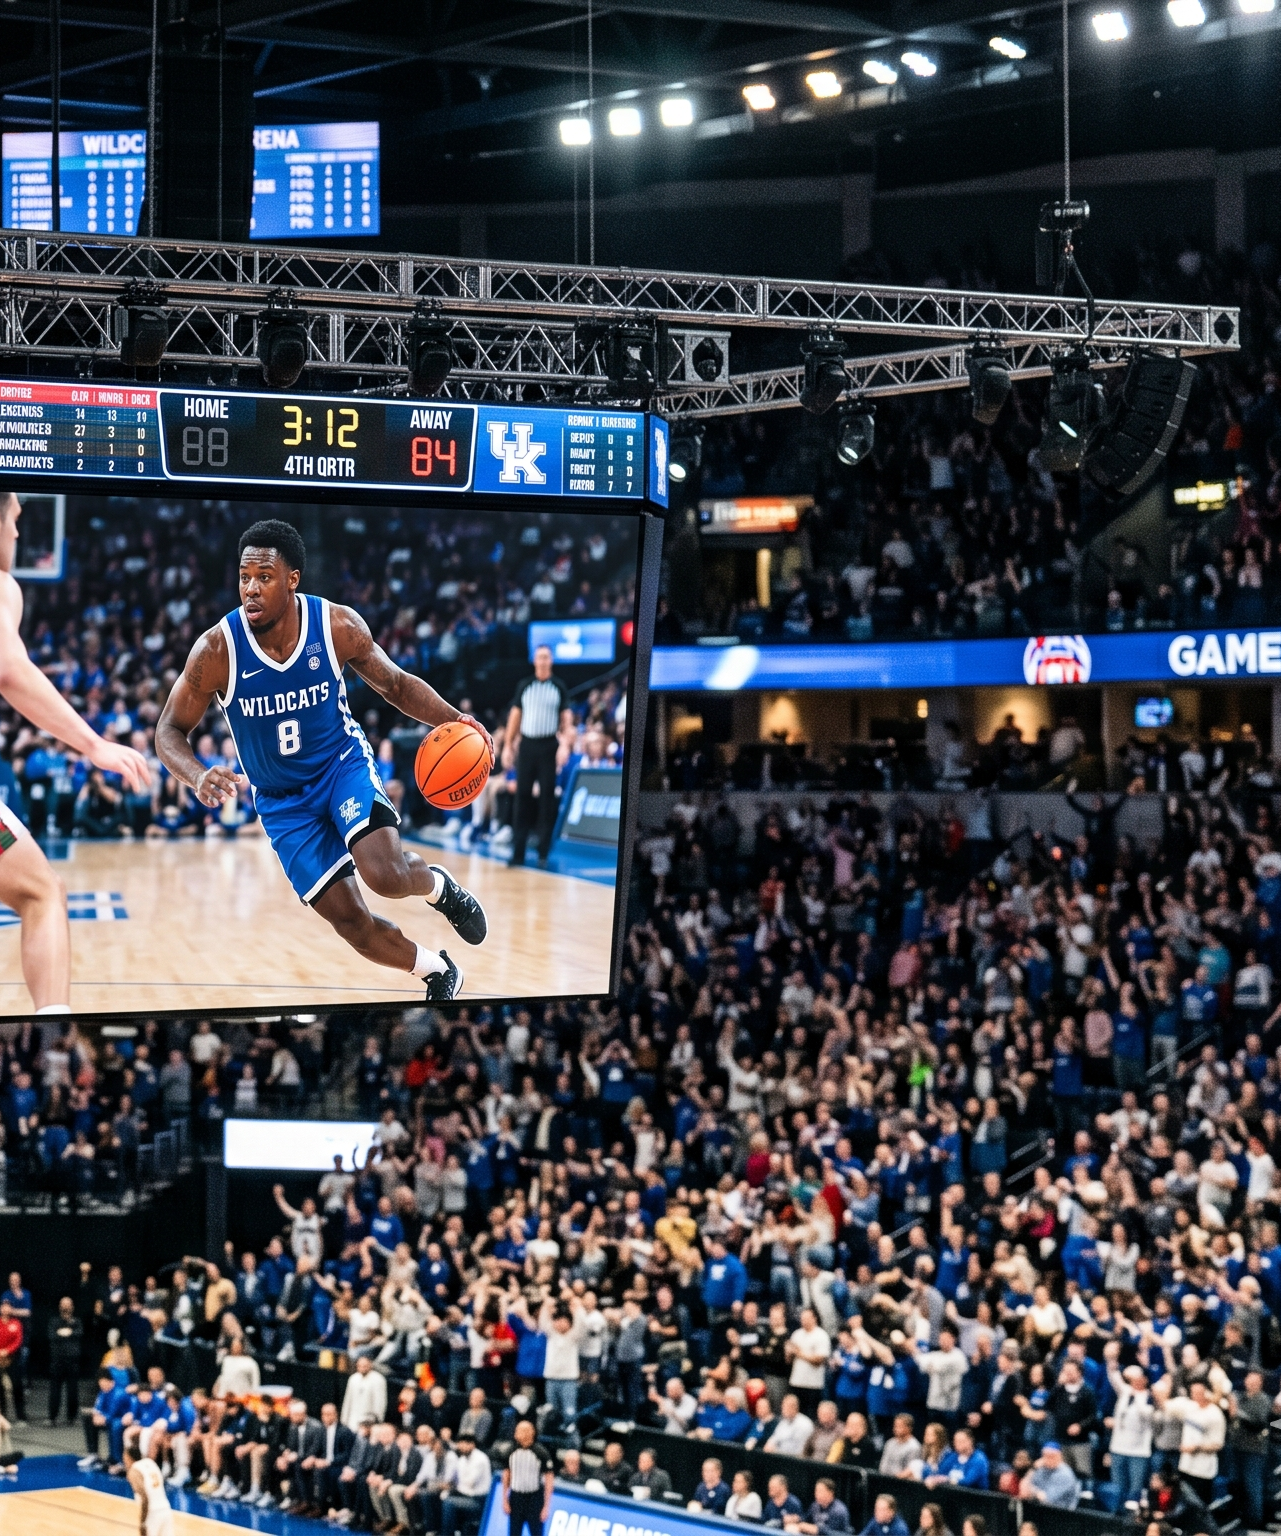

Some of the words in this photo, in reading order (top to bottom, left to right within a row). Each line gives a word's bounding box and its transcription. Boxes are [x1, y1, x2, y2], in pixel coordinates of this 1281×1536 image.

[184, 397, 229, 419] HOME
[410, 409, 453, 430] AWAY
[74, 424, 86, 437] 27
[108, 426, 115, 438] 3
[283, 405, 359, 448] 3:12
[109, 443, 114, 455] 1
[411, 436, 457, 477] 84
[487, 421, 547, 485] UK
[77, 459, 84, 471] 2
[108, 460, 115, 472] 2
[283, 455, 314, 476] 4TH
[317, 456, 355, 477] QRTR
[1168, 631, 1281, 677] GAME
[238, 681, 329, 717] WILDCATS
[276, 718, 302, 757] 8
